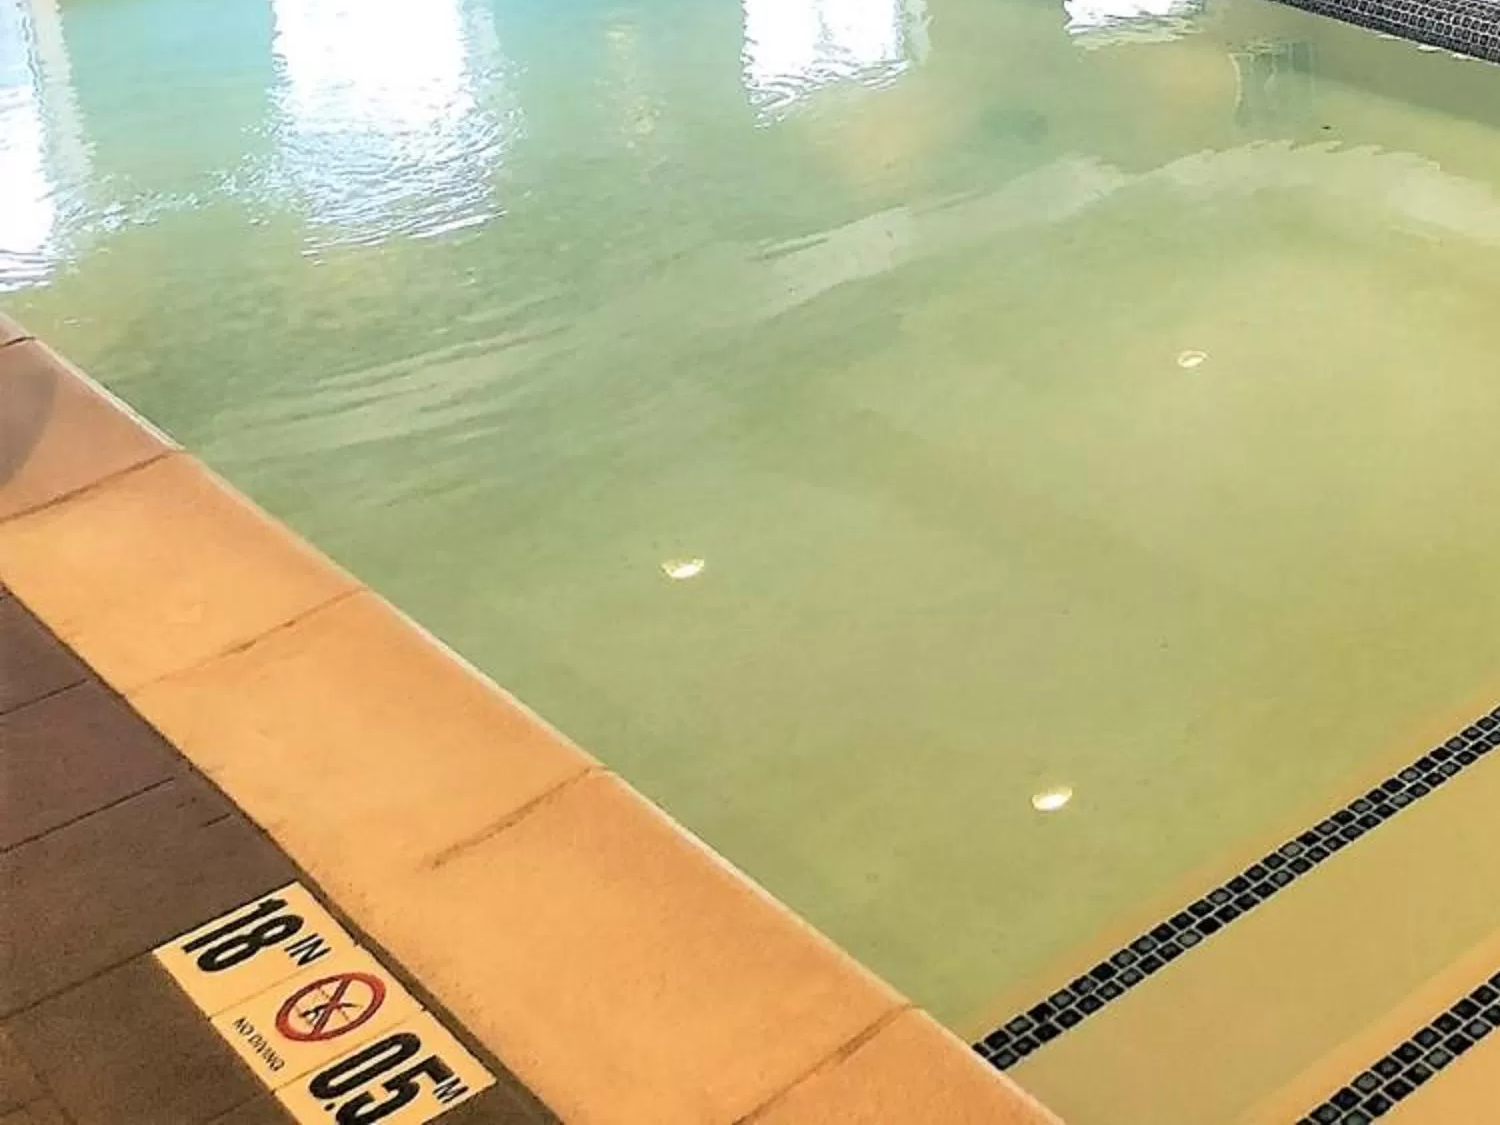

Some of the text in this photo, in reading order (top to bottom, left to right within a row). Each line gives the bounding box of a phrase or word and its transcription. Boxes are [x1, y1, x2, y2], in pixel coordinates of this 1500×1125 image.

[180, 897, 331, 973] 18 IN
[432, 1077, 469, 1104] M
